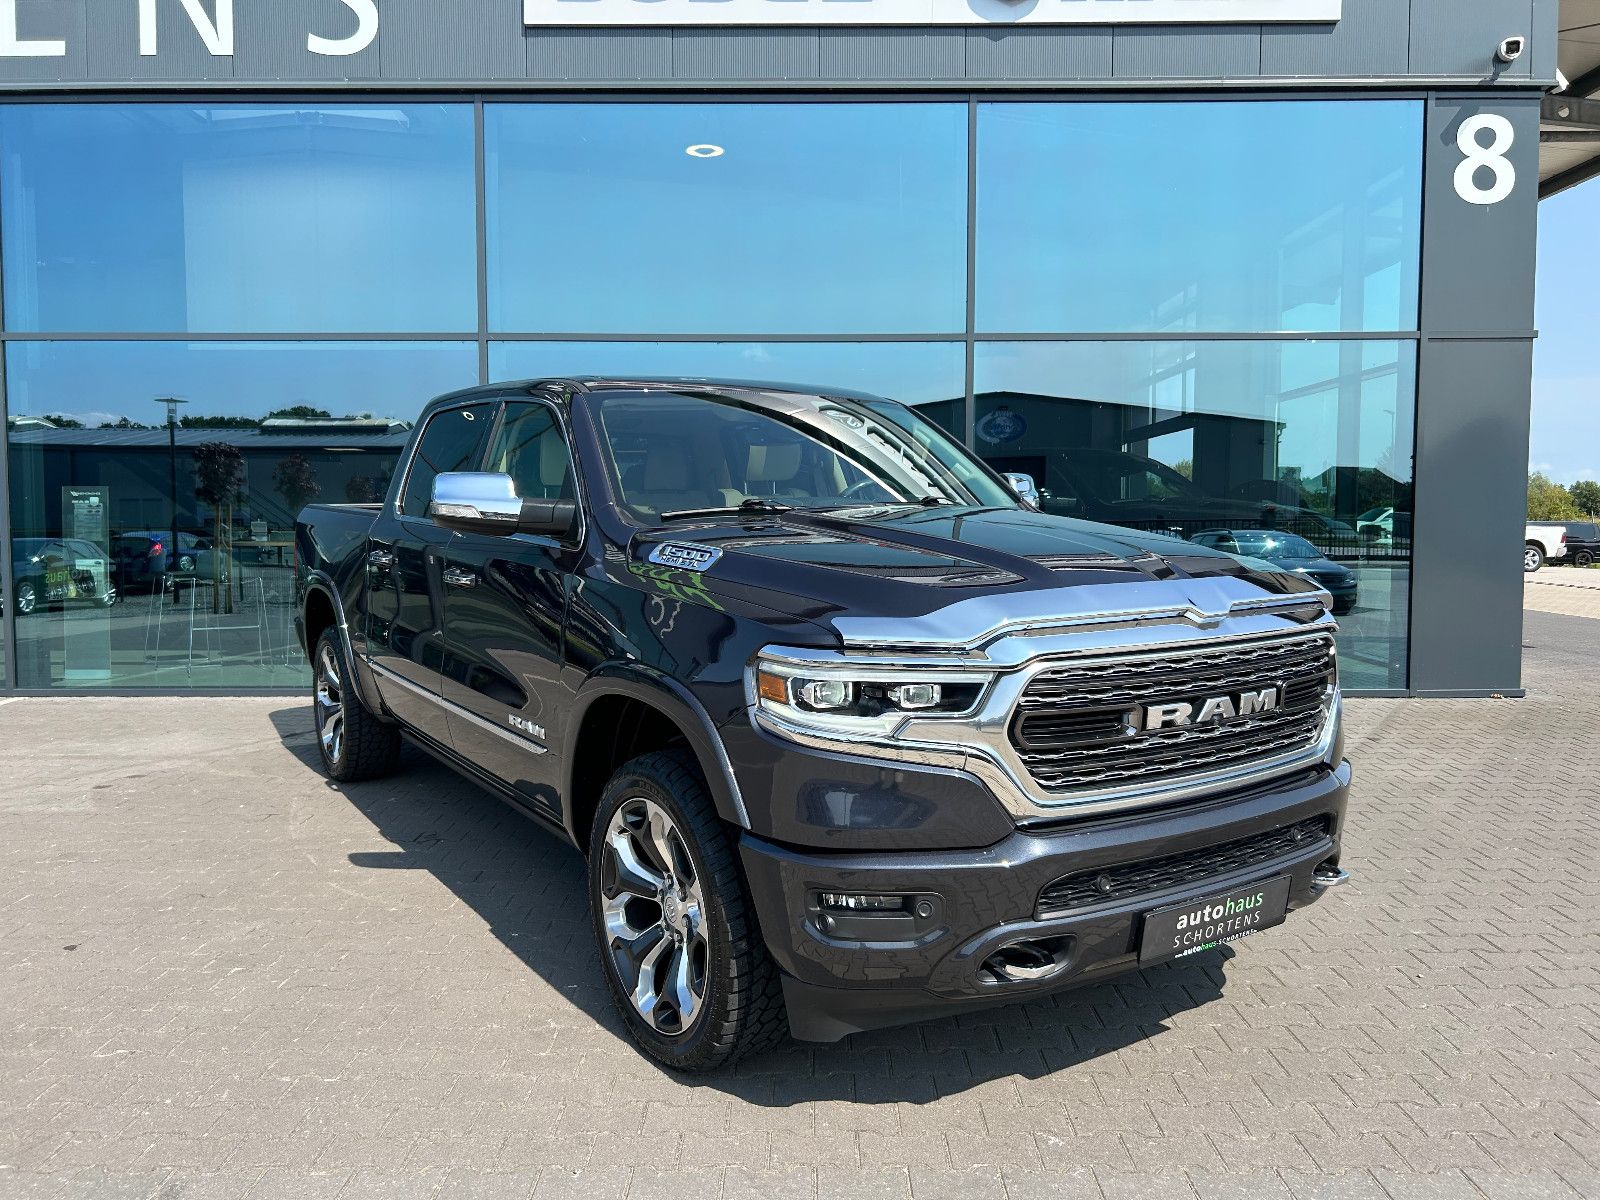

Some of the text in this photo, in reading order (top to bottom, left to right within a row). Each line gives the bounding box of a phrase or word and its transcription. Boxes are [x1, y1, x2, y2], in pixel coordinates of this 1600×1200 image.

[1453, 113, 1516, 205] 8
[664, 545, 711, 562] 1500
[508, 713, 546, 740] RAM
[1146, 687, 1277, 730] RAM
[1173, 910, 1261, 948] SCHORTENS
[1176, 892, 1264, 930] autohaus
